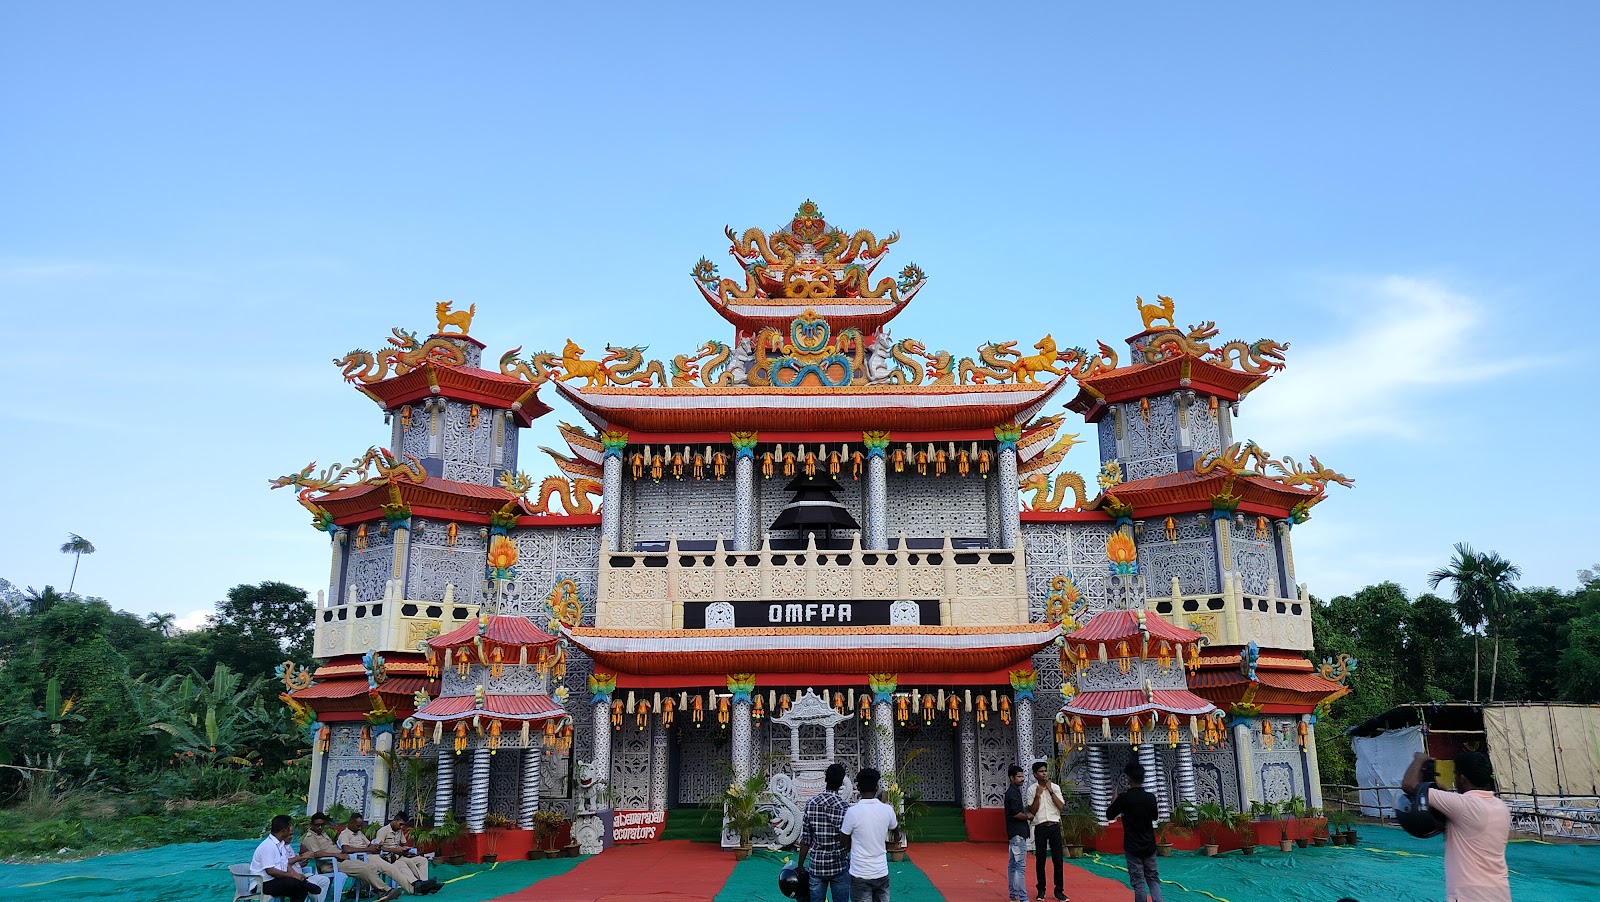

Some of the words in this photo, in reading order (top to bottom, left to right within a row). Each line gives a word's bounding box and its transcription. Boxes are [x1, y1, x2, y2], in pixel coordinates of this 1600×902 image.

[768, 603, 852, 623] OMFPA
[613, 811, 665, 827] atyanarayan
[613, 825, 656, 841] ecorators
